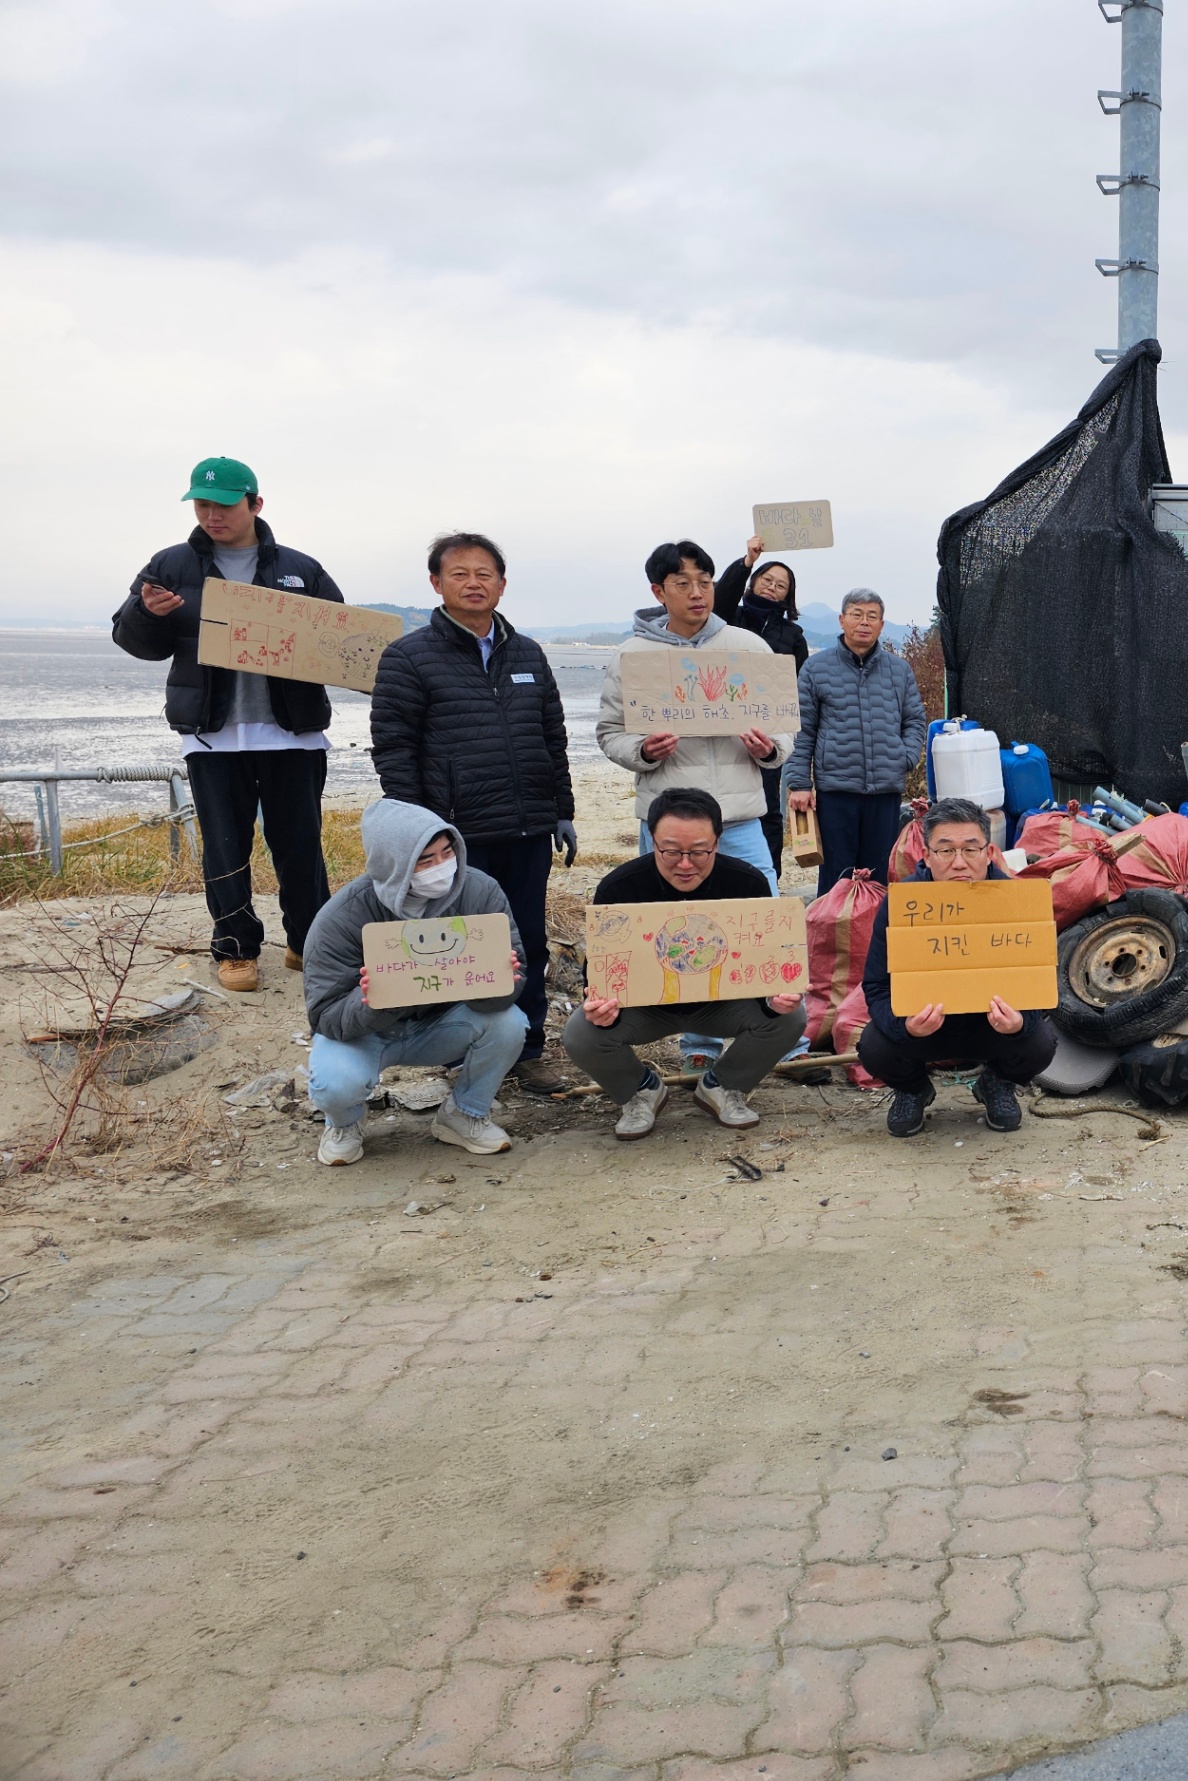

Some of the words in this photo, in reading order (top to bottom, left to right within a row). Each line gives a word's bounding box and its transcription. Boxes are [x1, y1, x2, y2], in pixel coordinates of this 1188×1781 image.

[662, 708, 695, 721] 뿌리의
[739, 703, 771, 720] 지구를
[903, 900, 965, 927] 우리가
[927, 934, 970, 957] 지킨
[991, 933, 1032, 948] 바다
[376, 960, 419, 973] 바다가
[434, 955, 476, 970] 살아야
[413, 975, 455, 992] 지구가
